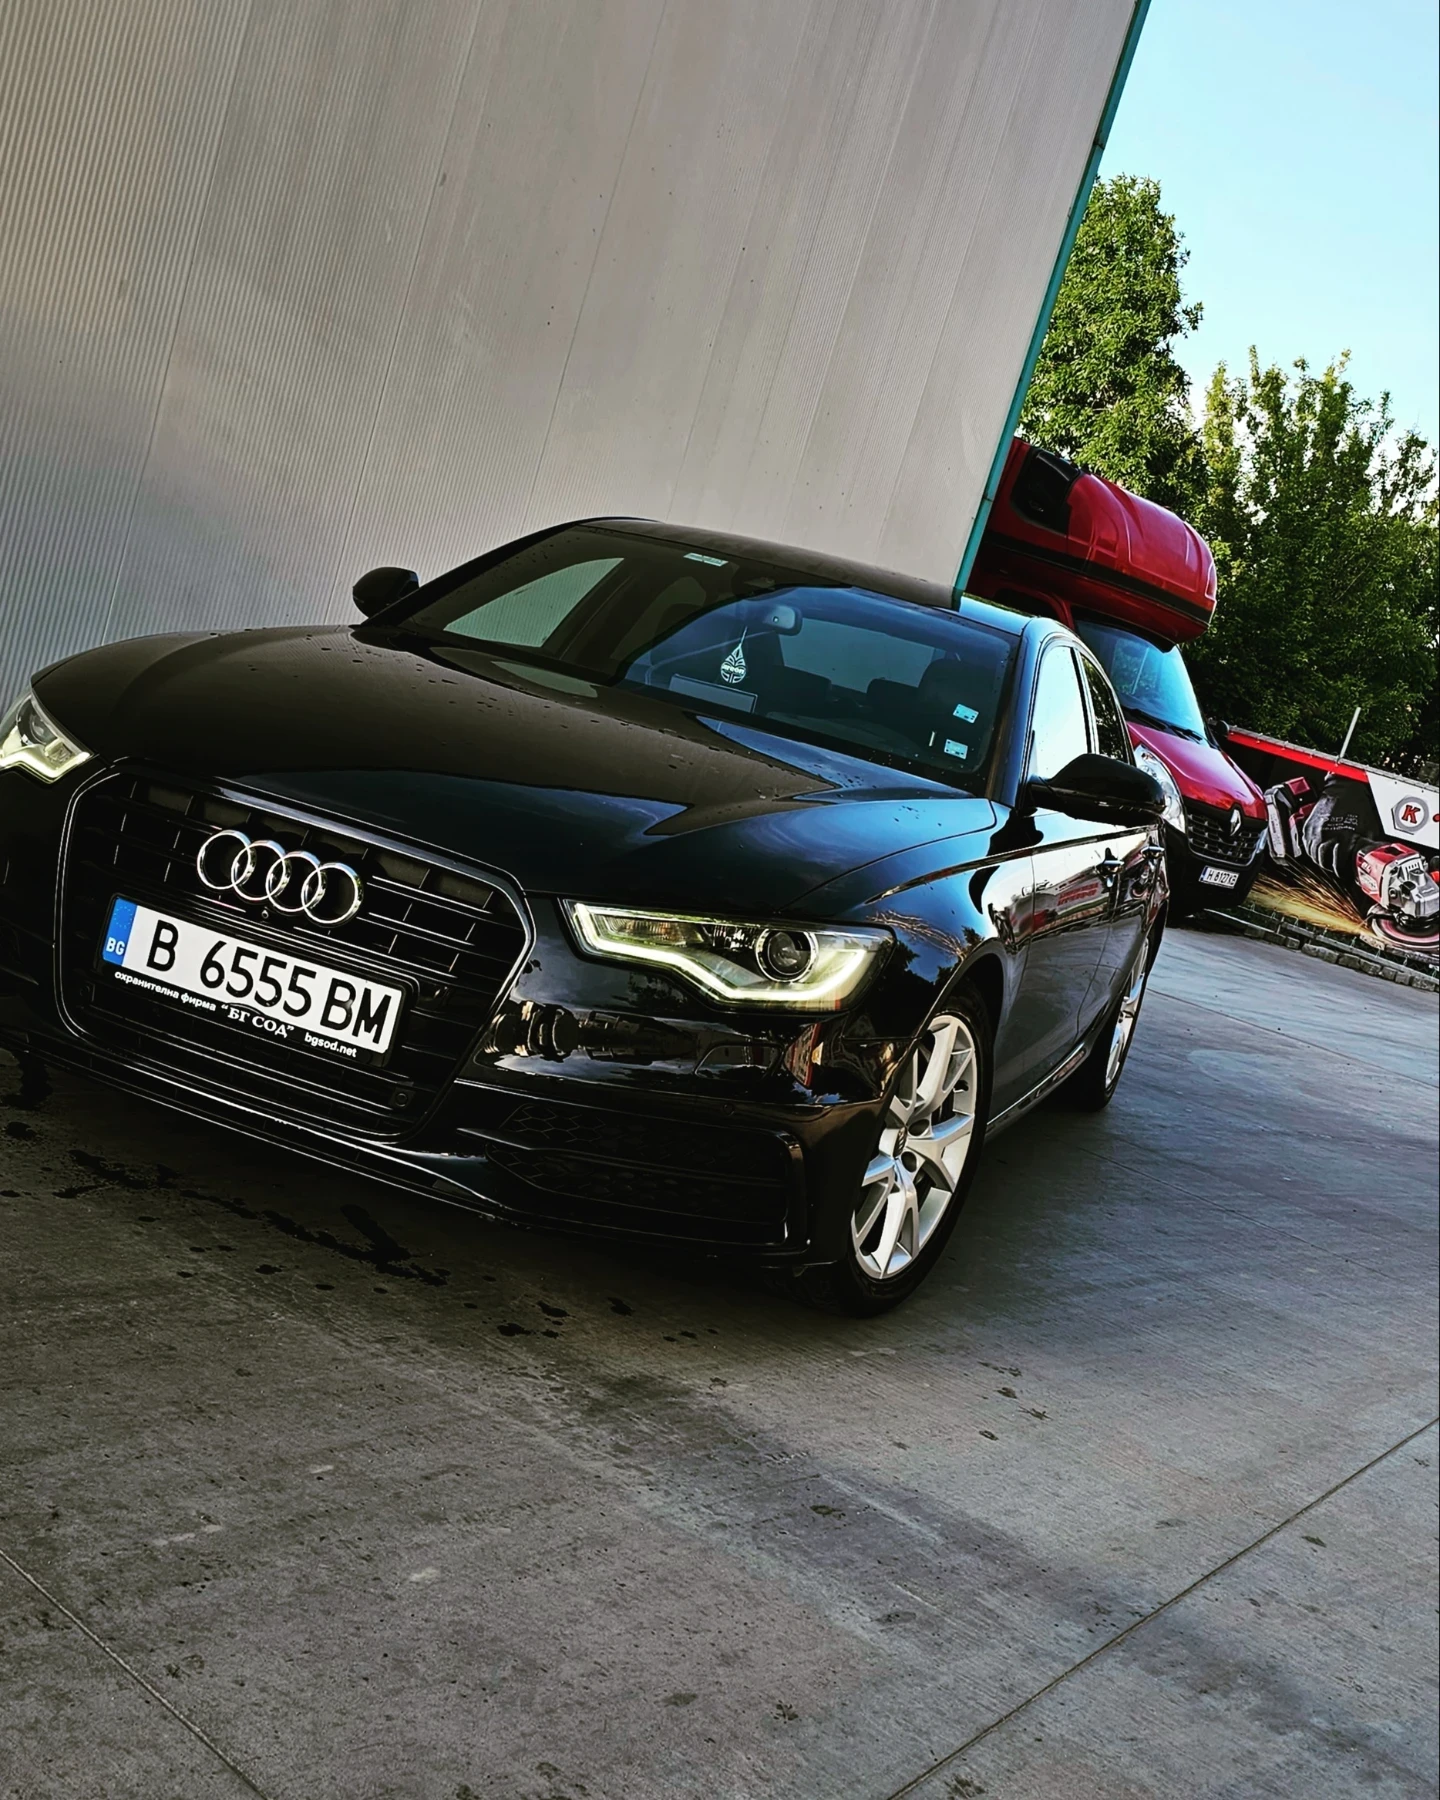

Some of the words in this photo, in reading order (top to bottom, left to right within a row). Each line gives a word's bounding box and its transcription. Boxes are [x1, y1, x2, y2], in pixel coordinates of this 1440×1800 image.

[1401, 804, 1421, 824] K
[106, 937, 125, 955] BG
[114, 971, 180, 999] охранителна
[181, 992, 217, 1011] фирма
[146, 919, 179, 972] B
[200, 940, 317, 1018] 6555
[320, 977, 392, 1044] BM
[304, 1032, 357, 1058] bgsod.net
